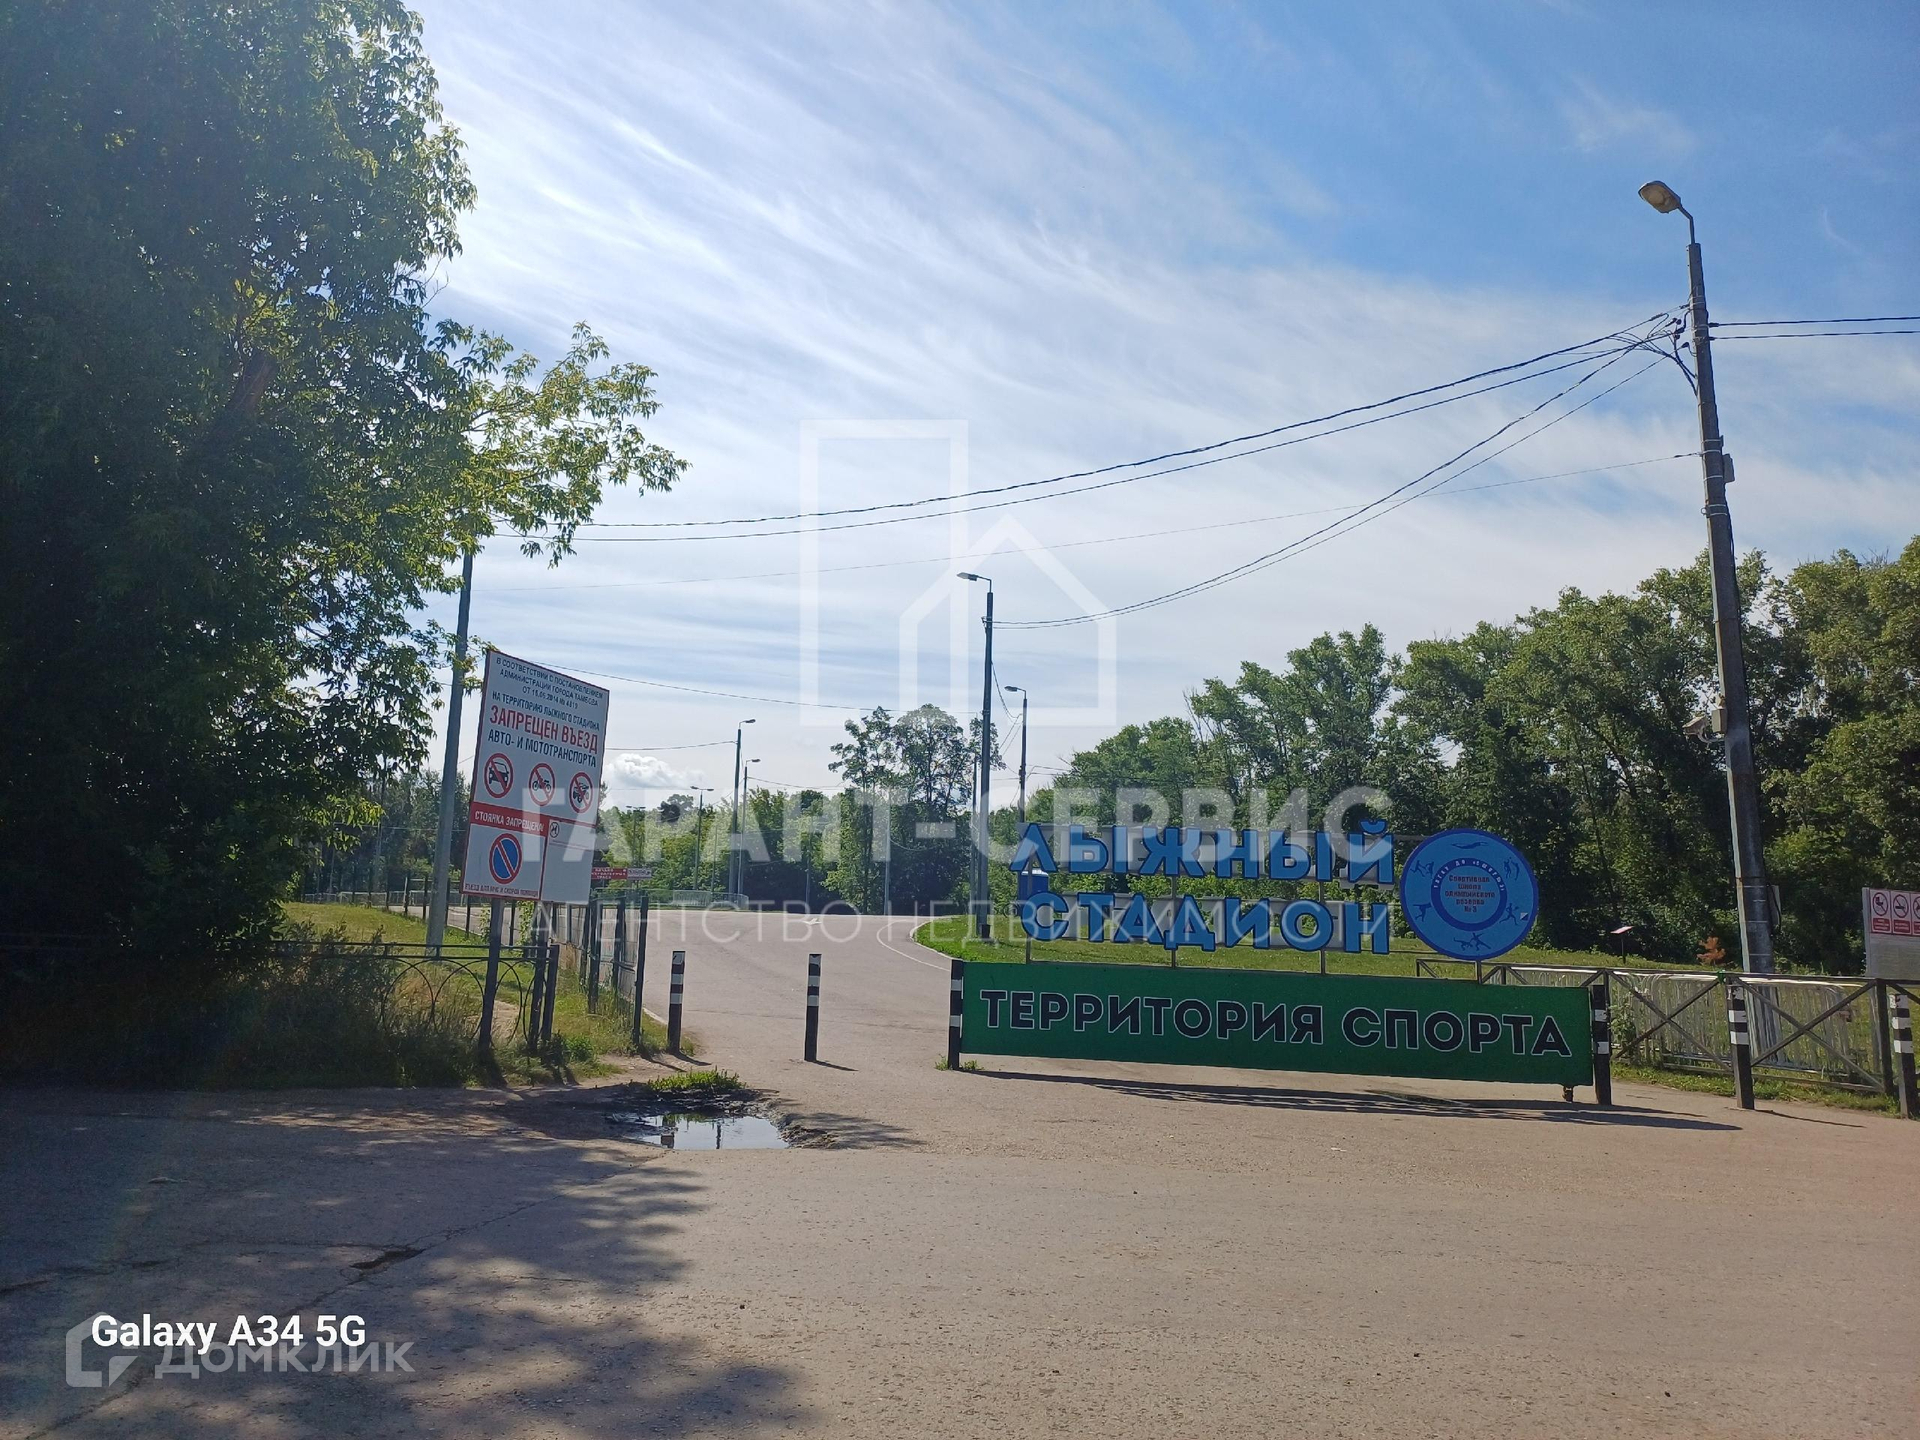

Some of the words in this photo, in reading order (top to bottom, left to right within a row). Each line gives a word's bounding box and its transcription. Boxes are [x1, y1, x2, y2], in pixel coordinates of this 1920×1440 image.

[500, 668, 551, 691] АДМИНИСТРАЦИИ
[552, 685, 574, 698] ГОРОДА
[574, 692, 598, 706] ТАМБОВА
[502, 659, 548, 680] СООТВЕТСТВИИ
[554, 676, 603, 699] ПОСТАНОВЛЕНИЕМ
[522, 686, 530, 695] ОТ
[489, 705, 558, 740] ЗАПРЕЩЕН
[561, 725, 598, 755] ВЪЕЗД
[492, 691, 502, 702] НА
[502, 694, 543, 713] ТЕРРИТОРИЮ
[543, 706, 573, 723] ЛЫЖНОГО
[573, 715, 600, 732] СТАДИОНА
[488, 729, 515, 746] АВТО-
[516, 737, 523, 749] И
[525, 738, 596, 768] МОТОТРАНСПОРТА
[475, 810, 504, 824] СТОЯНКА
[1009, 819, 1395, 885] ЛЫЖНЫЙ
[1020, 891, 1391, 955] СТАДИОН
[980, 989, 1324, 1045] ТЕРРИТОРИЯ
[1341, 1007, 1573, 1058] СПОРТА
